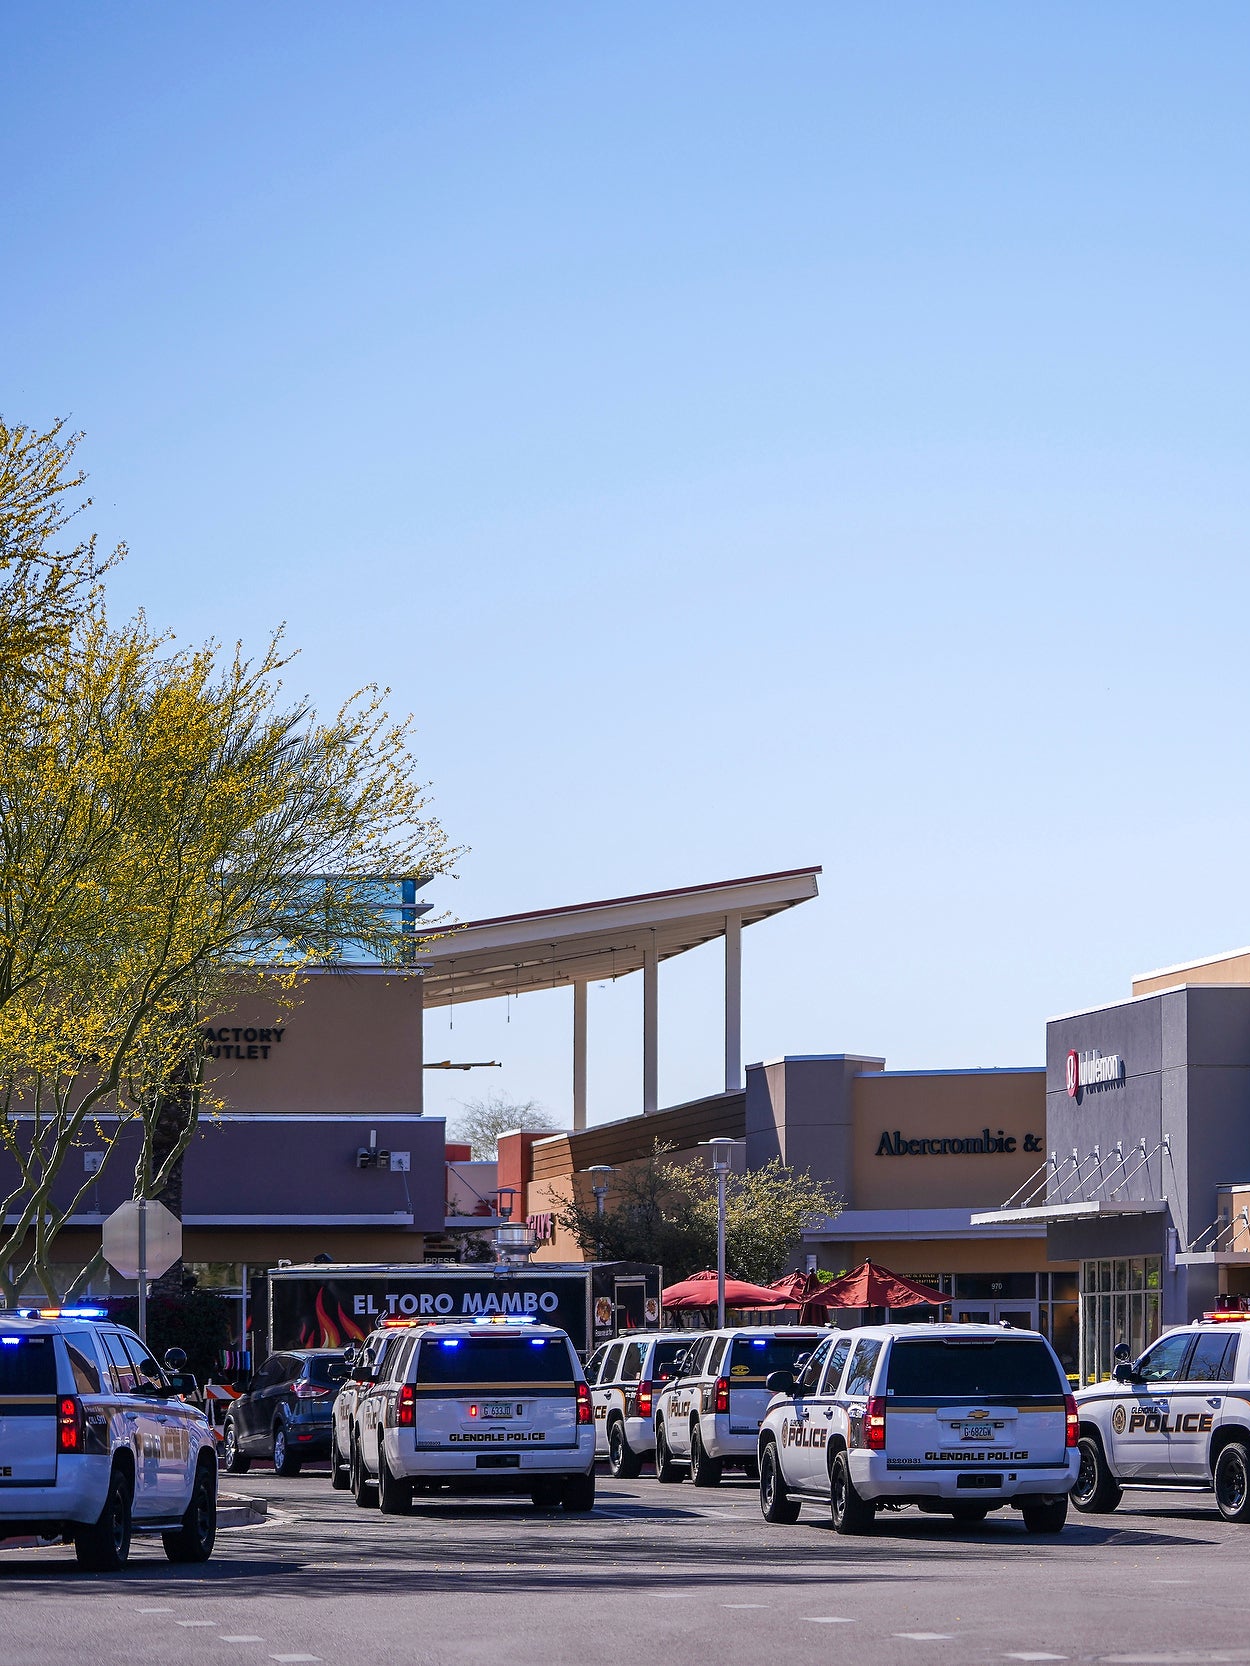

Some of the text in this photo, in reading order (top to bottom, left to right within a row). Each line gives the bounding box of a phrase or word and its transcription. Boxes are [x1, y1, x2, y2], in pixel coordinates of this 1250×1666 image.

[203, 1027, 286, 1042] ACTORY
[206, 1045, 272, 1059] UTLET
[875, 1128, 1043, 1156] Abercrombie &
[991, 1282, 1003, 1291] 970
[353, 1291, 559, 1315] EL TORO MAMBO
[1128, 1413, 1214, 1433] POLICE
[449, 1432, 545, 1442] GLENDALE POLICE
[787, 1427, 827, 1447] POLICE
[924, 1451, 1029, 1461] GLENDALE POLICE
